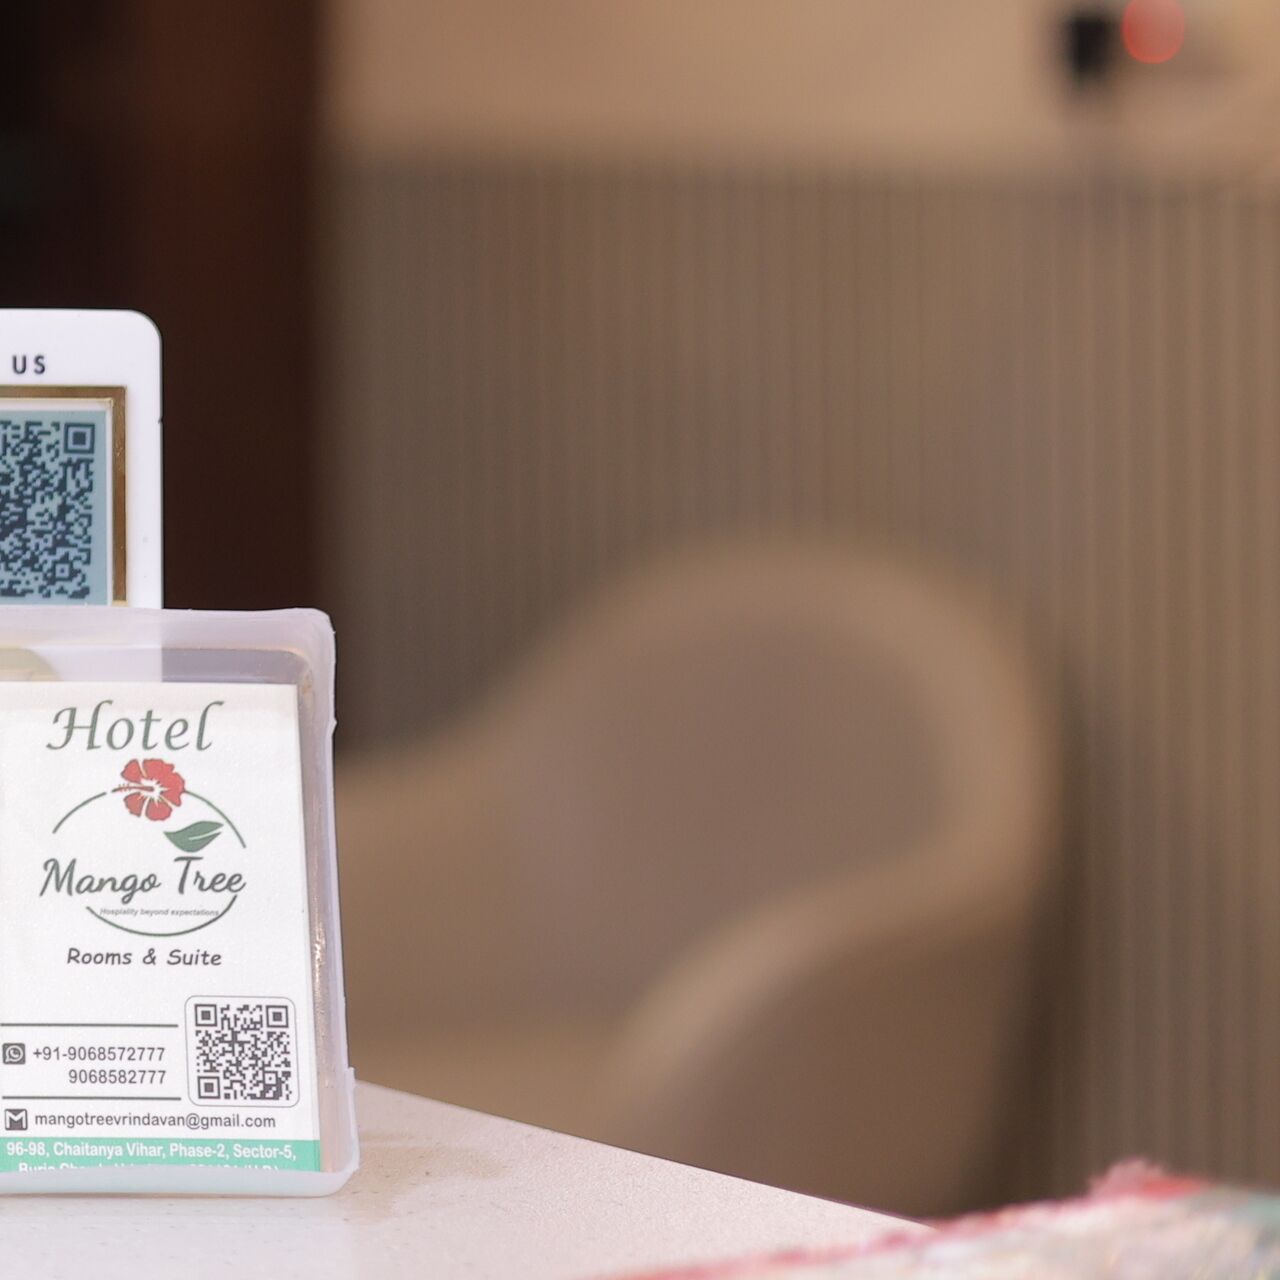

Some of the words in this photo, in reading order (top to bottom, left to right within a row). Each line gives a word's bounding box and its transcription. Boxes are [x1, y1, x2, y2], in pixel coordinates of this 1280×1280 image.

[13, 355, 45, 375] US
[46, 700, 224, 751] Hotel
[40, 858, 161, 904] Mango
[174, 856, 246, 894] Tree
[140, 908, 169, 917] beyond
[171, 909, 219, 917] expectations
[67, 948, 132, 965] Rooms
[143, 948, 156, 965] &
[167, 949, 221, 966] Suite
[33, 1046, 165, 1061] +91-9068572777
[69, 1069, 166, 1084] 9068582777
[35, 1113, 275, 1130] mangotreevrindavan@gmail.com
[6, 1142, 50, 1158] 96-98,
[53, 1142, 123, 1160] Chaitanya
[126, 1143, 167, 1159] Vihar,
[169, 1143, 229, 1160] Phase-2,
[233, 1144, 297, 1161] Sector-5,
